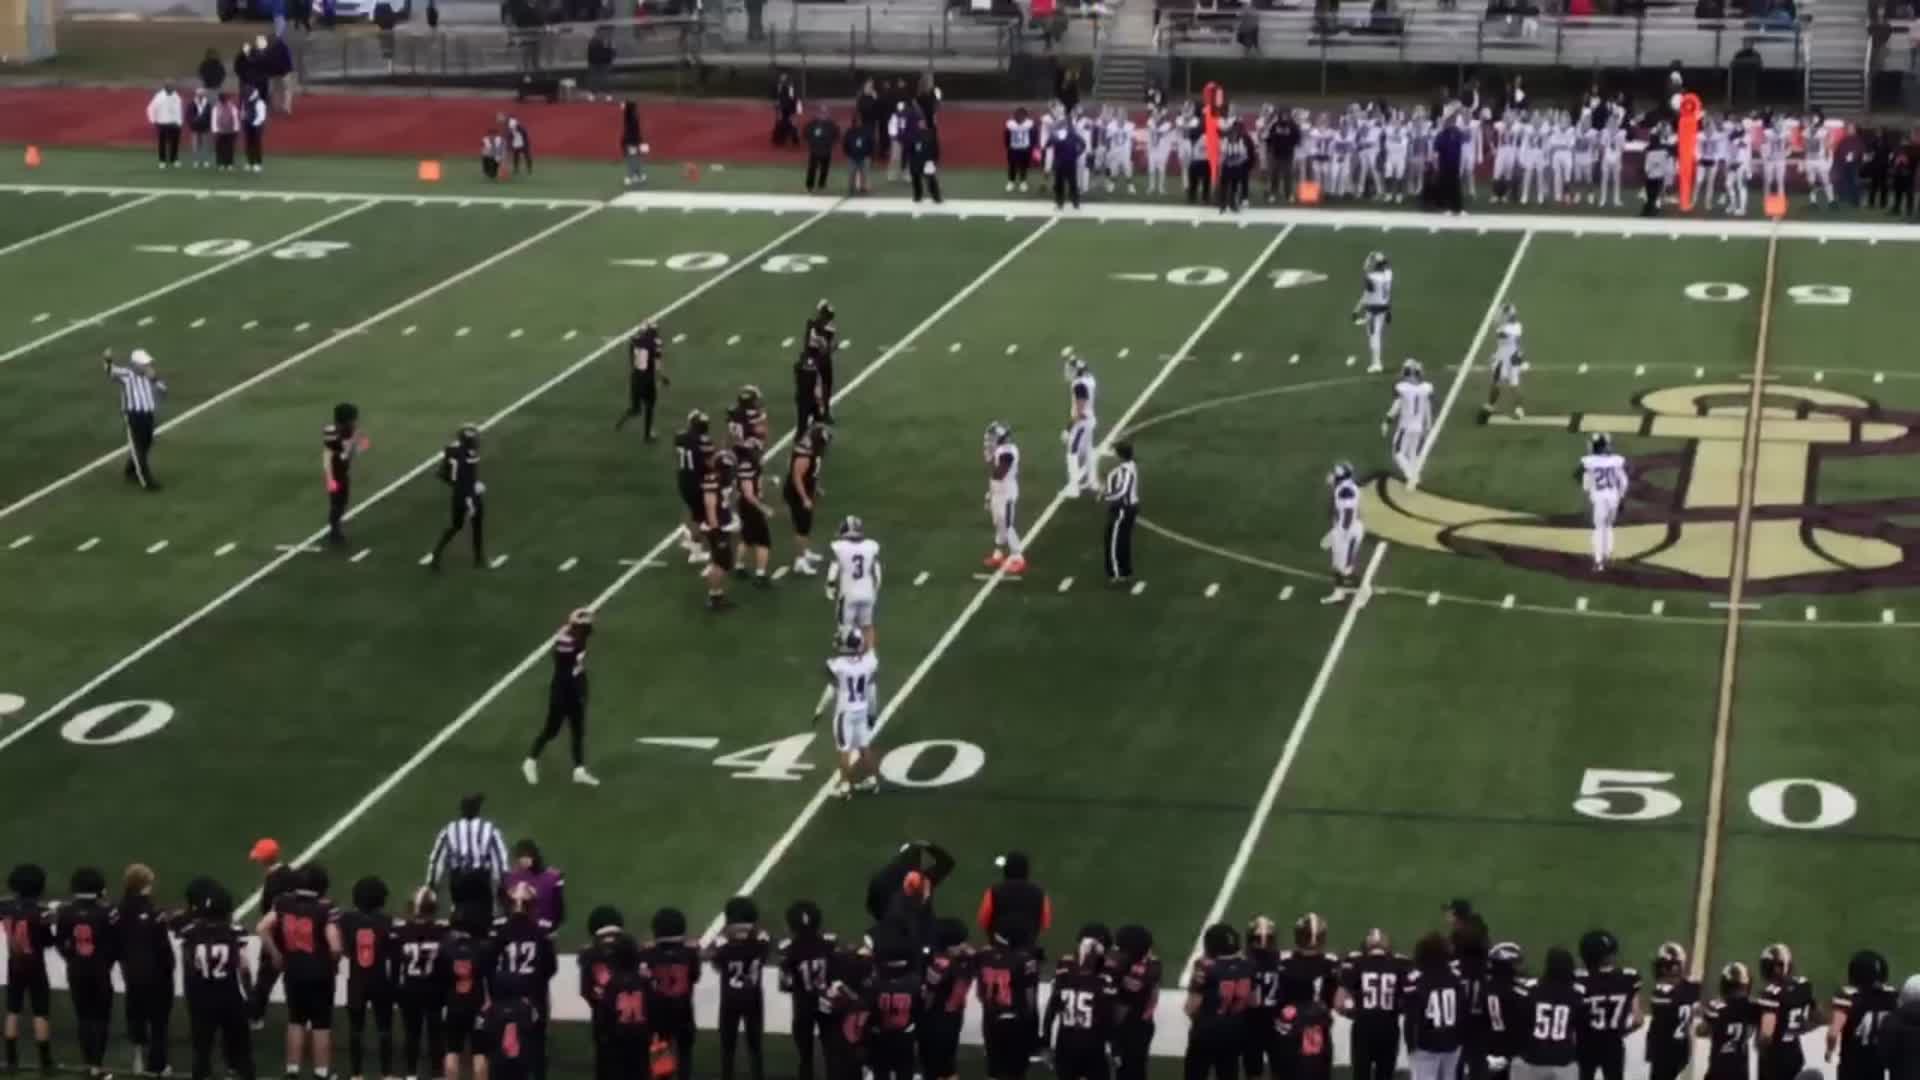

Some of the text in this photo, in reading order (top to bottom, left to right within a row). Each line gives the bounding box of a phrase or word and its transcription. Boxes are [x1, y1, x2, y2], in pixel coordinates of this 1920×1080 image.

[851, 554, 864, 579] 3
[846, 675, 866, 702] 14
[712, 732, 986, 787] 40
[1572, 767, 1857, 829] 50
[402, 941, 440, 977] 27
[505, 941, 537, 974] 12
[1060, 988, 1095, 1029] 35
[1361, 971, 1397, 1010] 56
[1425, 988, 1457, 1028] 40
[1590, 994, 1628, 1029] 57
